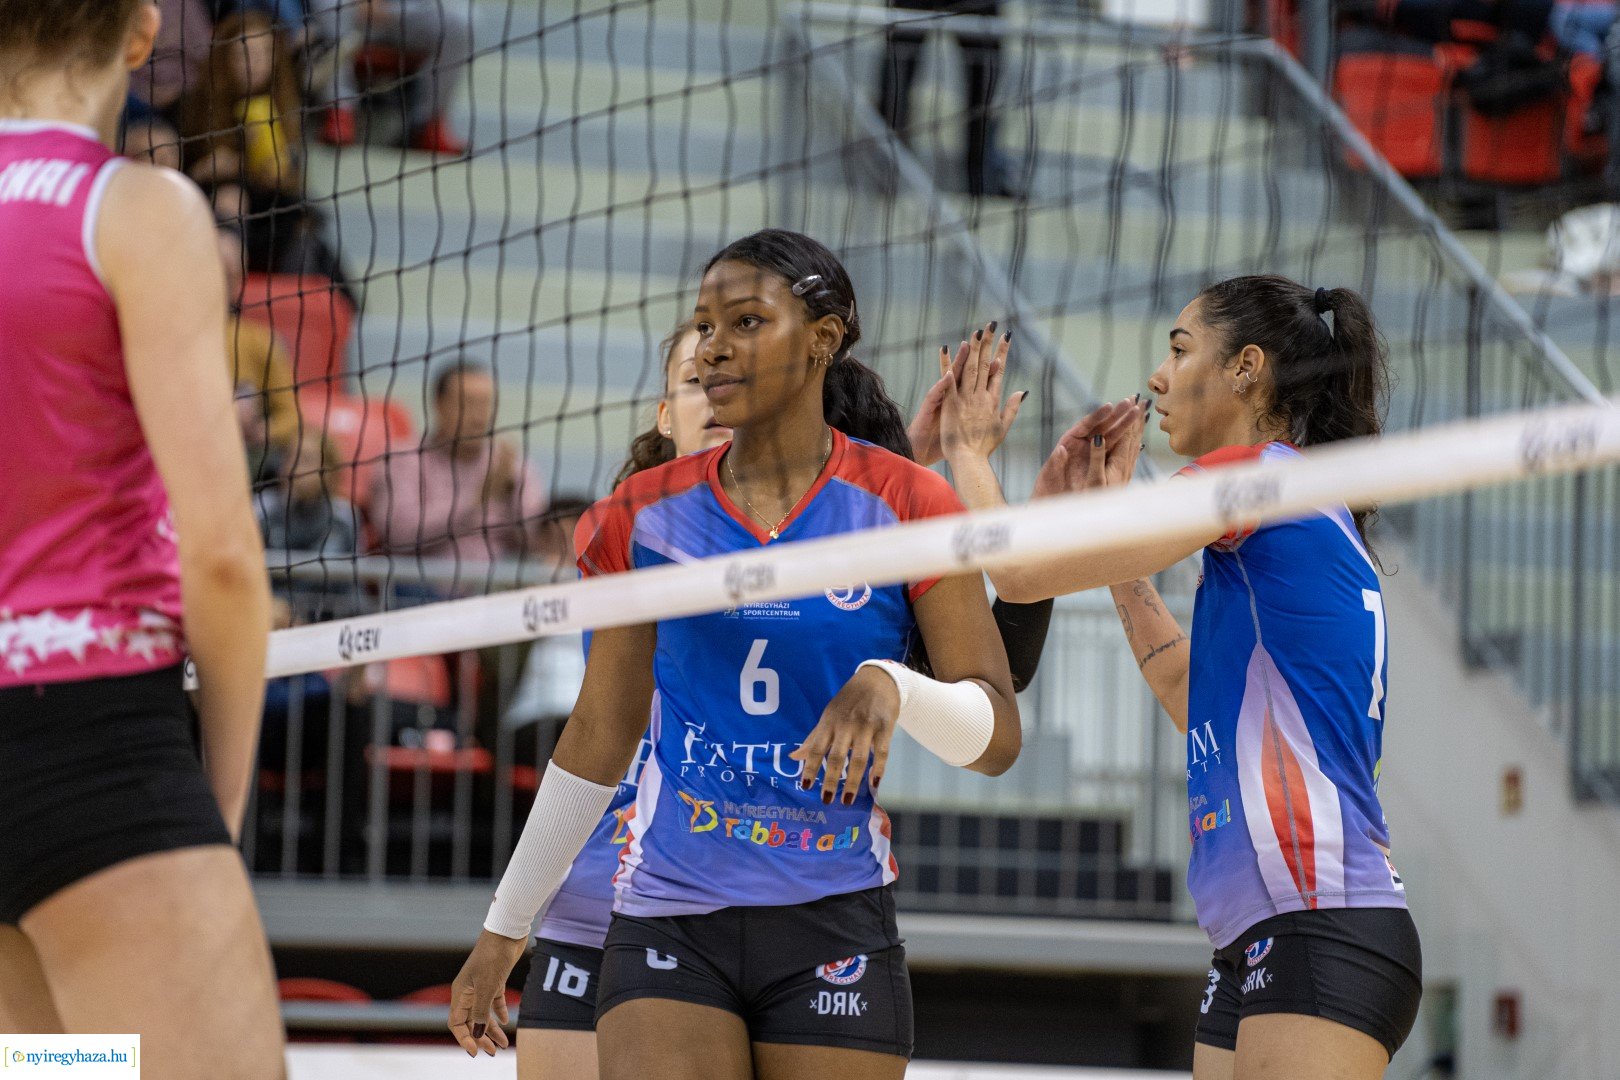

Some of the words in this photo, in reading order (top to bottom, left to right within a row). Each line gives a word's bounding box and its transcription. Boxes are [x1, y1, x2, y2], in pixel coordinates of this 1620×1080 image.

[354, 627, 382, 652] CEV
[739, 638, 780, 716] 6
[680, 764, 847, 793] PROPER
[723, 800, 828, 824] NYÍREGYHÁZA
[1201, 798, 1231, 832] ad!
[723, 817, 813, 851] Többet
[816, 825, 860, 851] ad!
